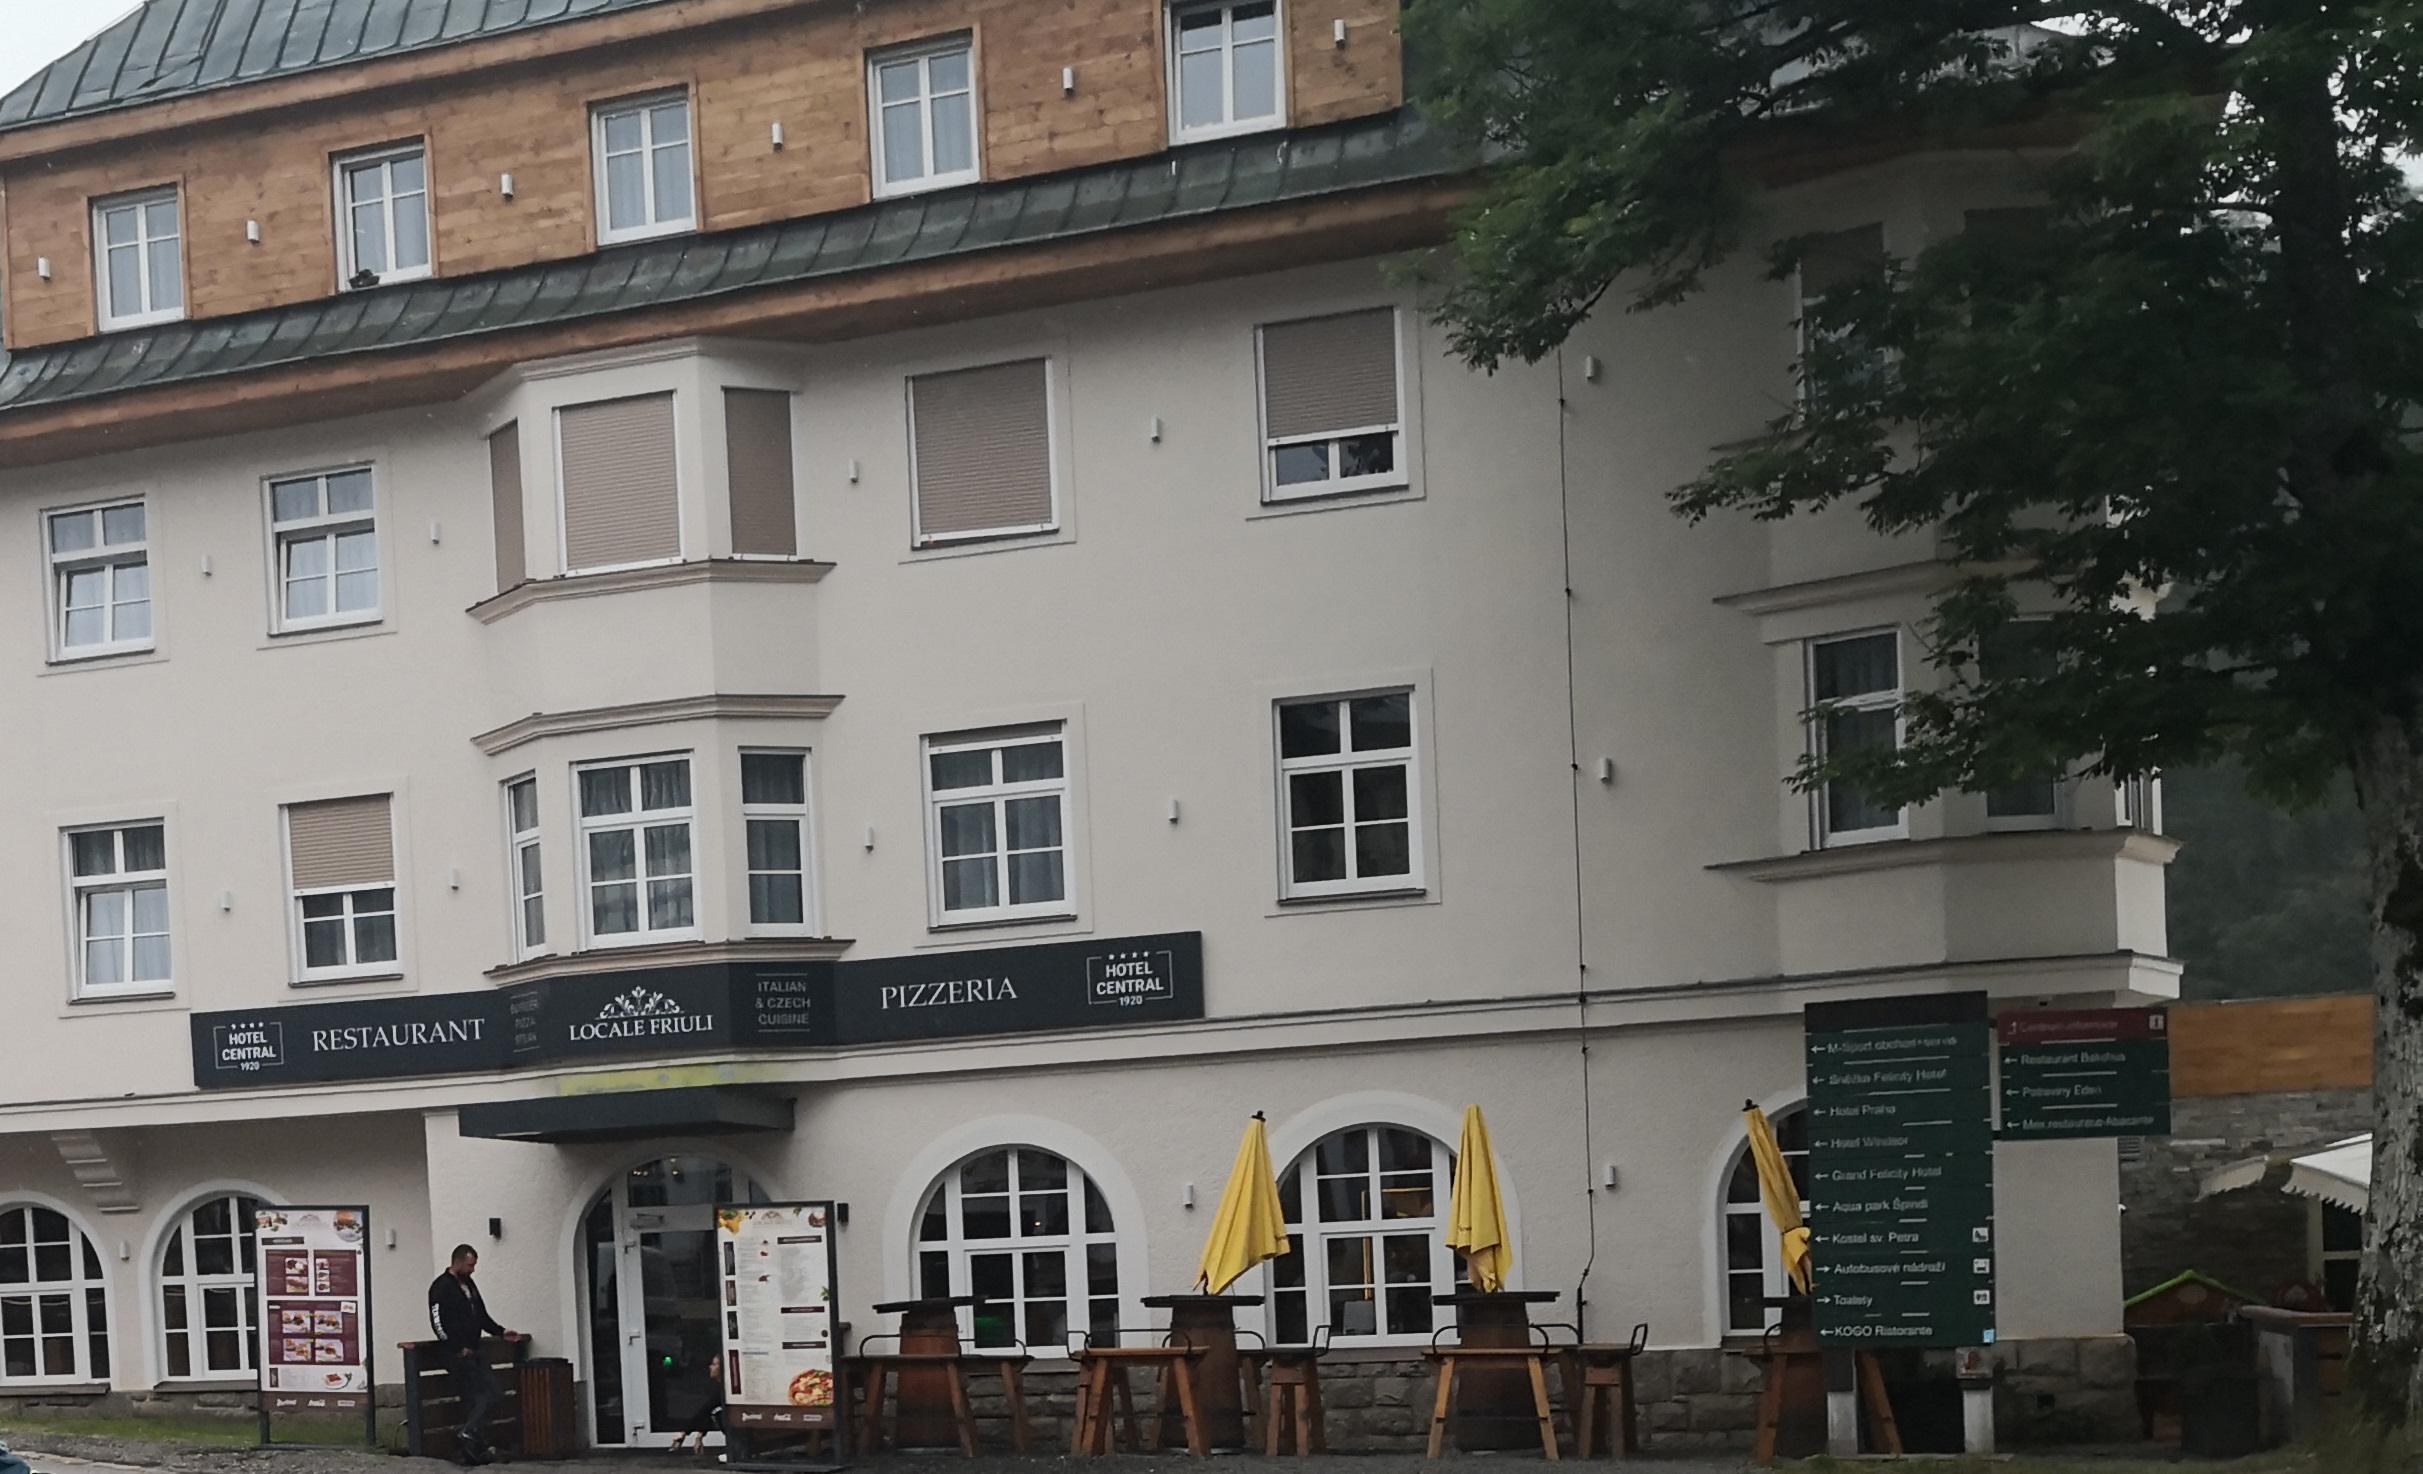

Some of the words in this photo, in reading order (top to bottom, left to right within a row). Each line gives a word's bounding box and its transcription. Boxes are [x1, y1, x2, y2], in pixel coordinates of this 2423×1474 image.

[1105, 961, 1154, 979] HOTEL
[757, 981, 807, 993] ITALIAN
[880, 976, 1019, 1010] PIZZERIA
[1096, 977, 1165, 996] CENTRAL
[766, 997, 812, 1009] CZECH
[1119, 995, 1143, 1007] 1920
[312, 1017, 486, 1052] RESTAURANT
[569, 1018, 646, 1041] LOCALE
[649, 1014, 714, 1036] FRIULI
[228, 1030, 268, 1046] HOTEL
[221, 1044, 277, 1062] CENTRAL
[240, 1061, 260, 1072] 1920
